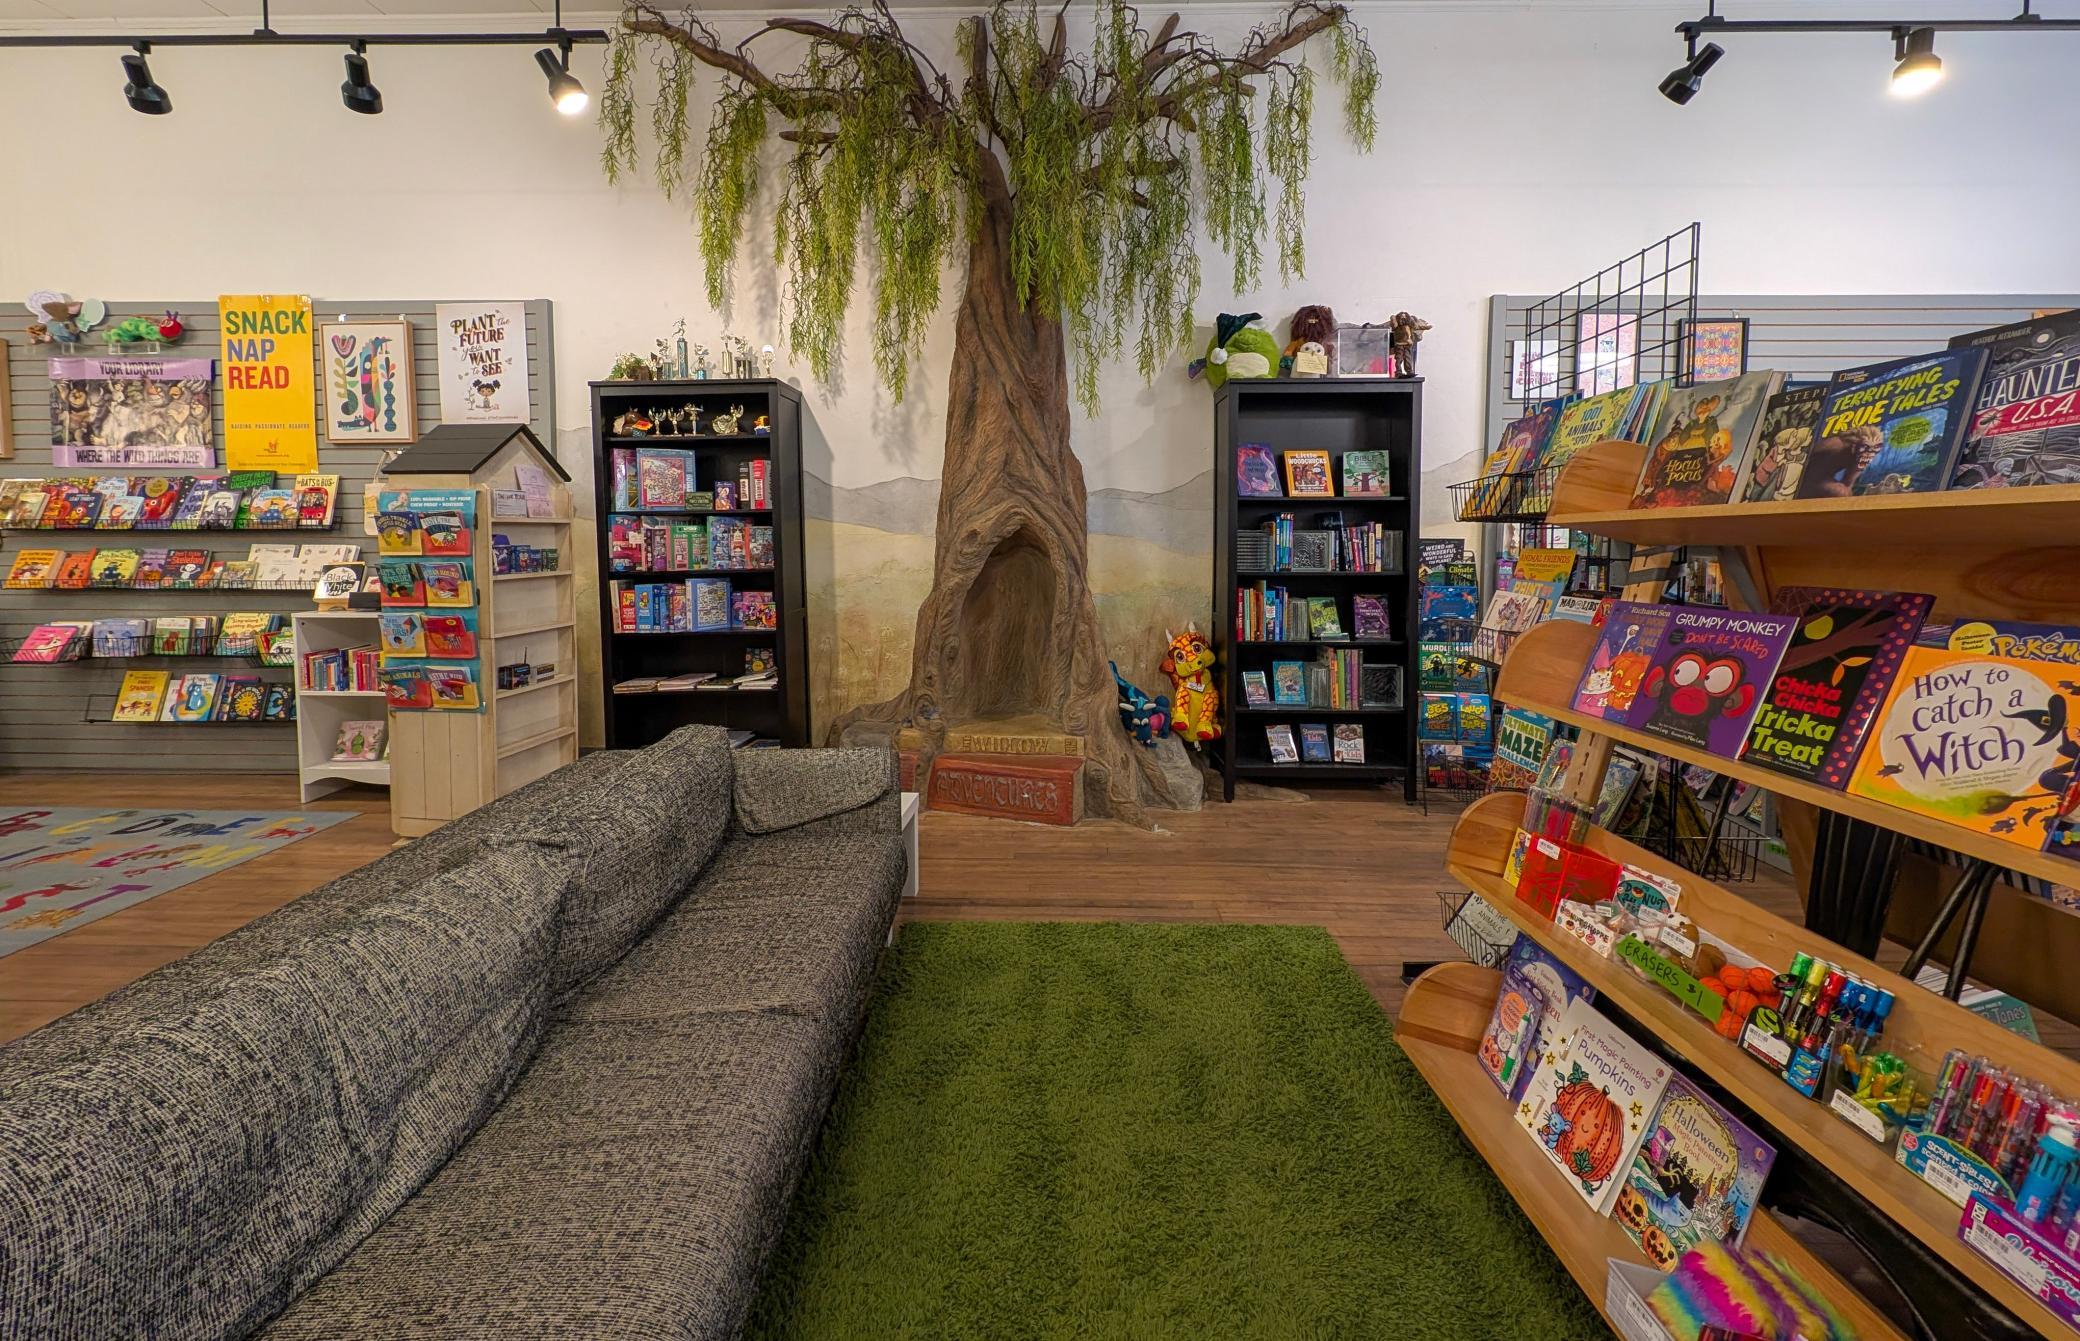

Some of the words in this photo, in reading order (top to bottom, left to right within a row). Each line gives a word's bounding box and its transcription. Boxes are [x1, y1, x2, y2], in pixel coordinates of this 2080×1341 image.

[225, 310, 307, 335] SNACK
[450, 313, 495, 334] PLANT
[496, 317, 511, 326] the
[460, 328, 504, 347] FUTURE
[227, 338, 275, 362] NAP
[462, 345, 483, 361] you
[469, 348, 501, 366] WANT
[100, 361, 123, 375] YOUR
[125, 361, 164, 375] LIBRARY
[228, 365, 290, 390] READ
[482, 362, 502, 376] SEE
[1832, 366, 1943, 413] TERRIFYING
[1582, 406, 1603, 421] 1001
[1822, 400, 1889, 438] TRUE
[1889, 379, 1960, 415] TALES
[2011, 392, 2077, 424] U.S.A.
[1567, 420, 1606, 438] ANIMALS
[1573, 434, 1592, 445] SPOT
[76, 450, 103, 463] WHERE
[105, 450, 121, 463] THE
[123, 450, 145, 463] WILD
[149, 450, 179, 464] THINGS
[182, 450, 201, 463] ARE
[1664, 457, 1704, 473] HOCUS
[1423, 548, 1456, 557] WONDERFUL
[1544, 554, 1571, 564] FRIENDS
[326, 573, 353, 582] Black
[1449, 565, 1474, 574] Climate
[1513, 581, 1543, 597] PAINT
[1561, 598, 1574, 608] MAD
[1582, 601, 1599, 611] LIBS
[1632, 607, 1657, 616] Richard
[1675, 613, 1726, 630] GRUMPY
[1726, 619, 1786, 637] MONKEY
[1422, 644, 1453, 652] MURDLE
[1716, 633, 1729, 645] BE
[1729, 634, 1769, 660] SCARED
[1775, 676, 1841, 701] Chicka
[1913, 670, 1972, 700] How
[1984, 667, 2010, 685] to
[1775, 692, 1841, 718] Chicka
[1912, 686, 1993, 732] catch
[2008, 688, 2024, 708] a
[1504, 715, 1547, 742] ULTIMATE
[1754, 703, 1836, 741] Tricka
[1500, 727, 1544, 763] MAZE
[1753, 726, 1824, 766] Treat
[1894, 725, 2025, 780] Witch
[1498, 747, 1540, 774] CHALLENGE
[1624, 941, 1680, 987] ERASERS
[1577, 1038, 1637, 1097] Pumpkins
[1581, 1024, 1596, 1042] First
[1597, 1038, 1618, 1061] Magic
[1619, 1055, 1652, 1090] Painting
[1672, 1105, 1729, 1164] Halloween
